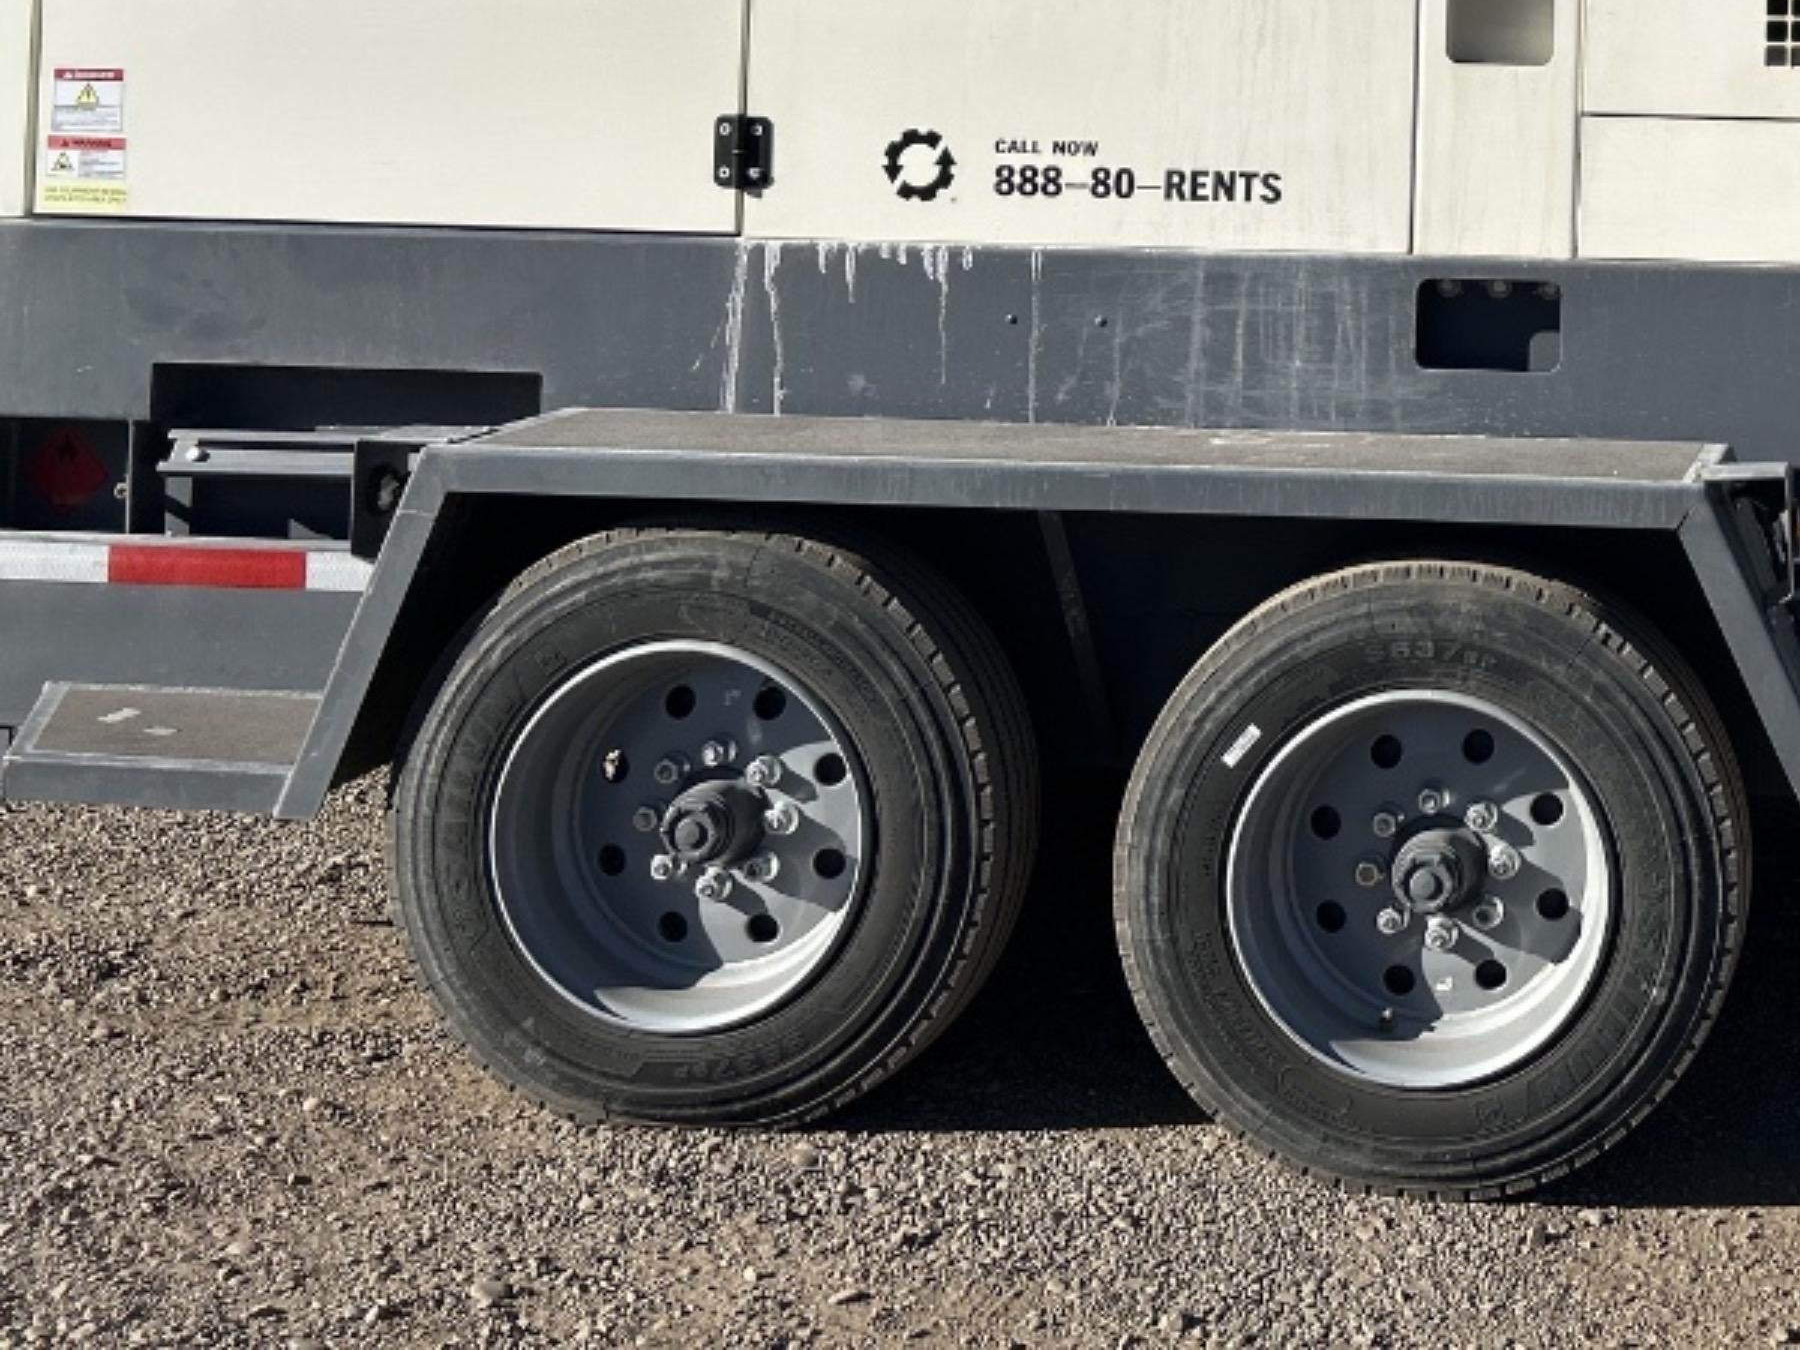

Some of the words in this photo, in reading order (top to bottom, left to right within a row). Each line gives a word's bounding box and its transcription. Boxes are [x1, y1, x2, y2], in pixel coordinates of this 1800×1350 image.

[994, 139, 1041, 155] CALL
[1052, 140, 1100, 157] NOW
[994, 164, 1283, 205] 888-80-RENTS
